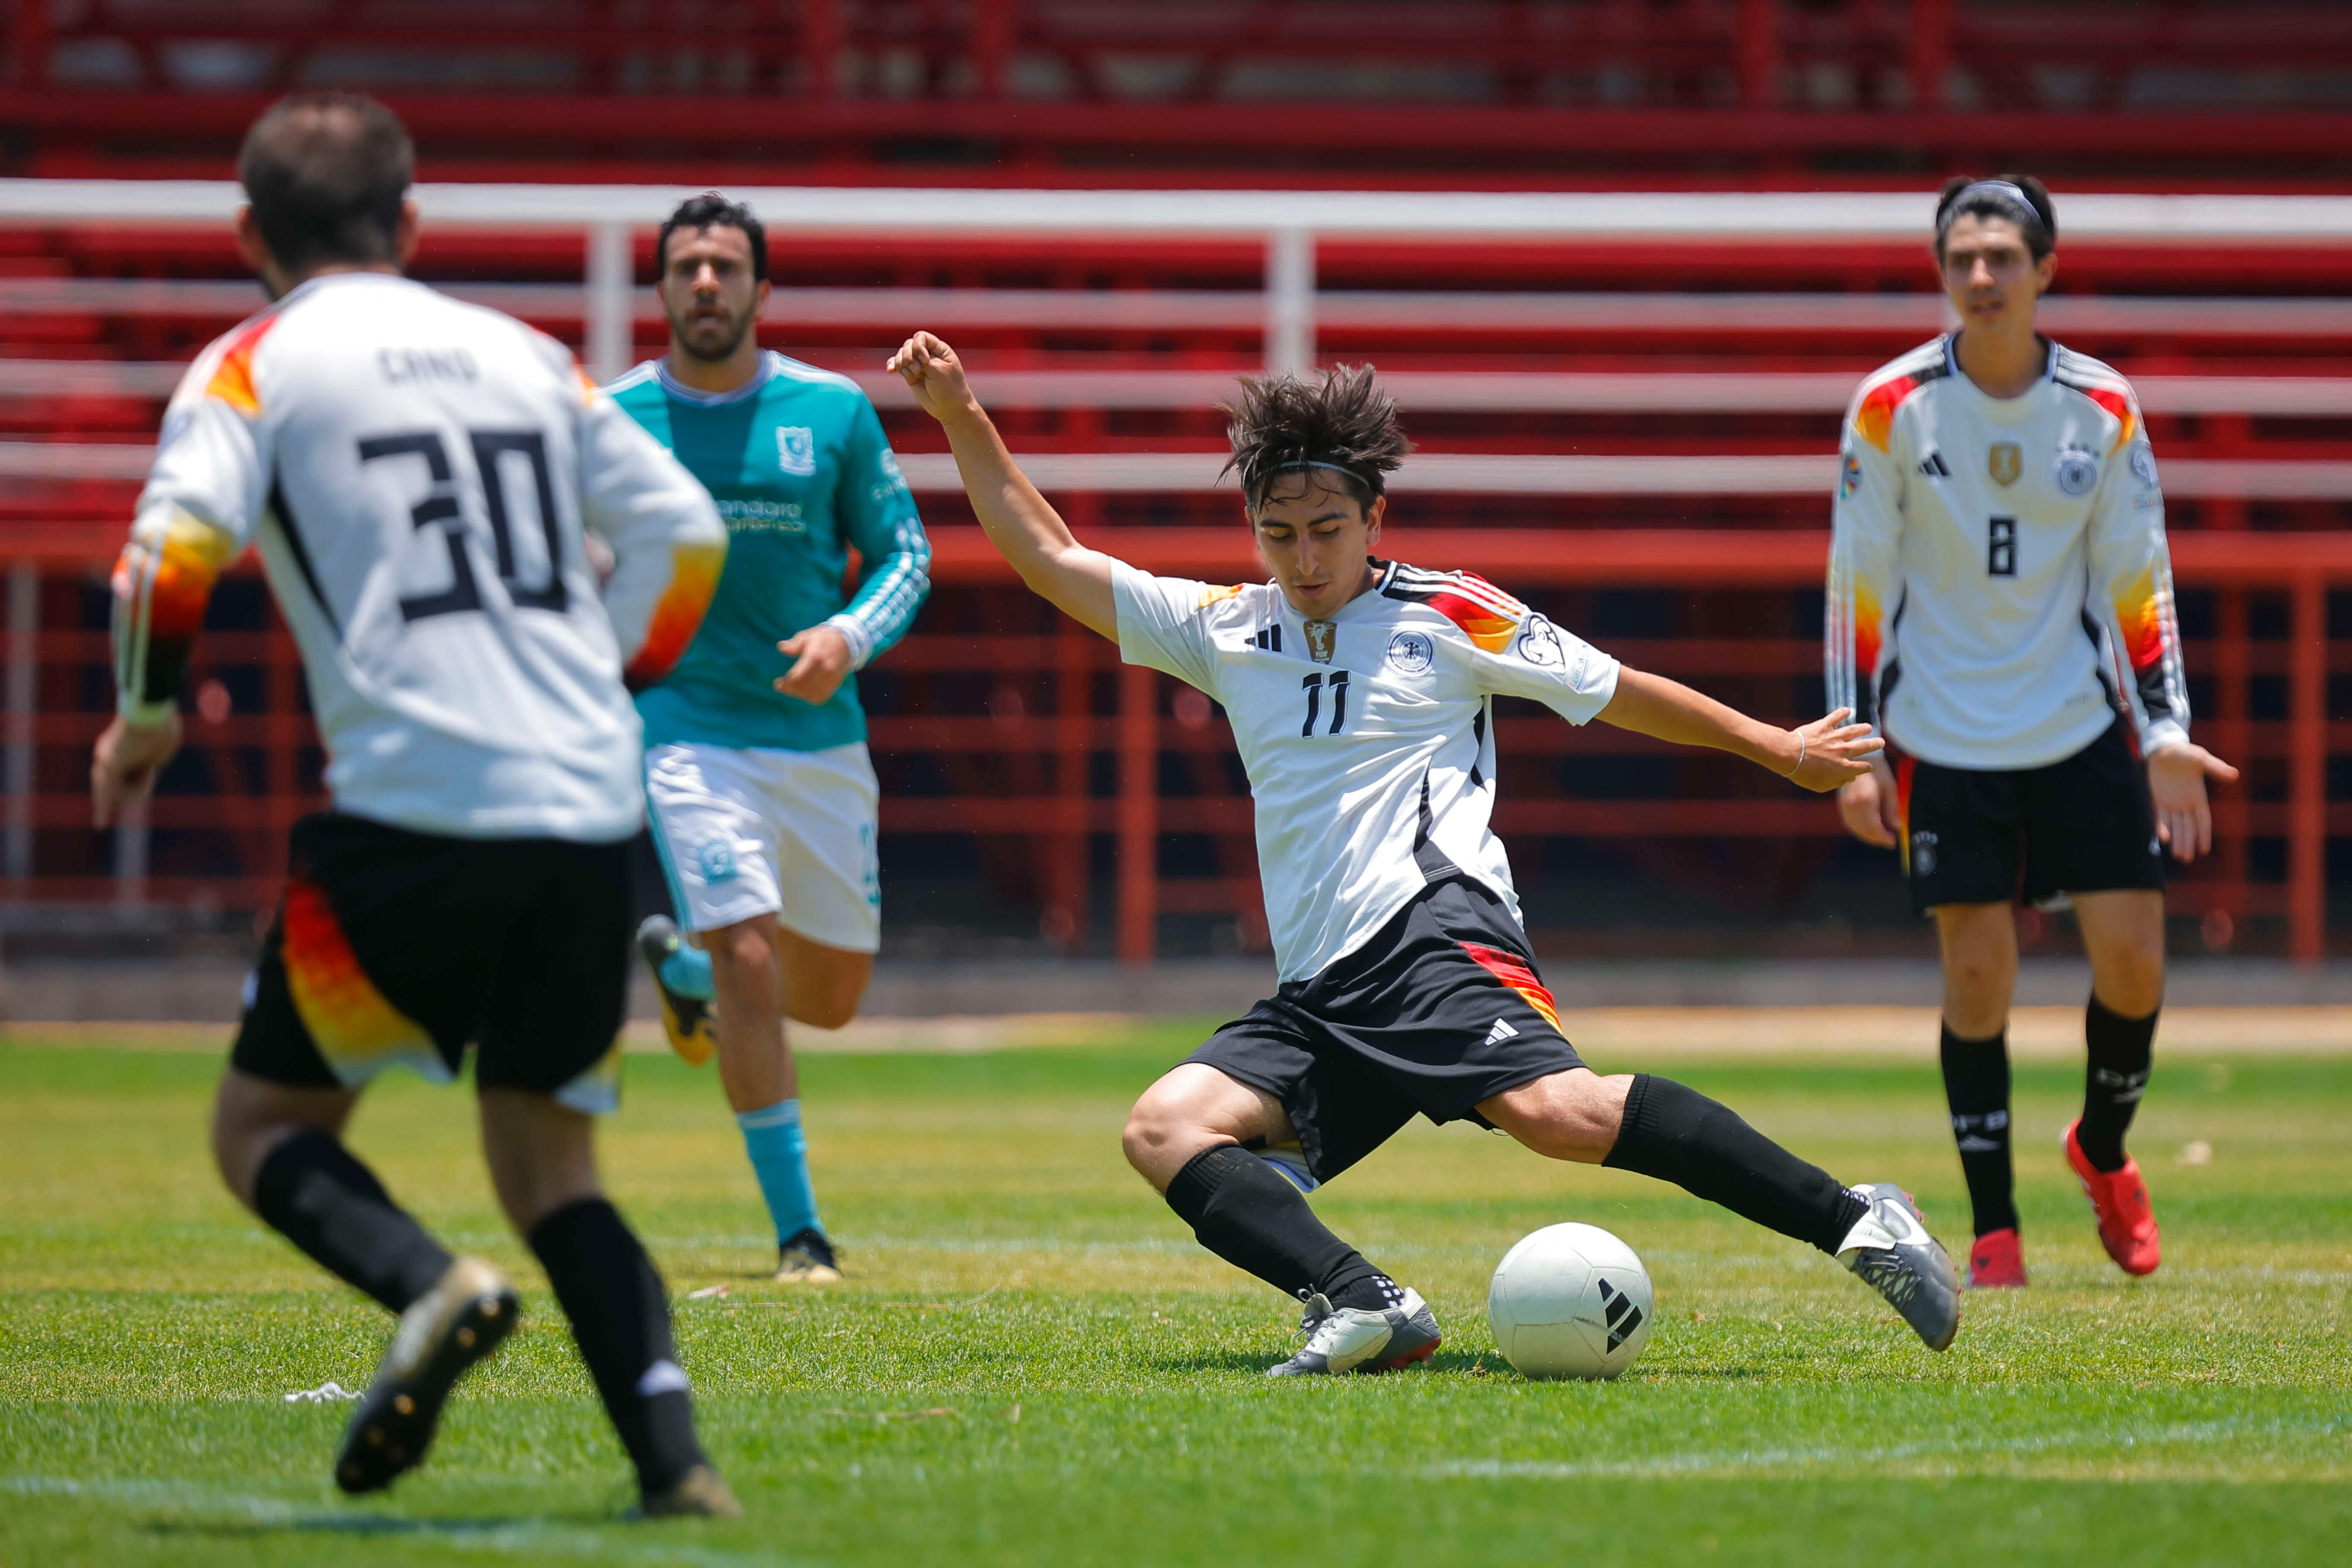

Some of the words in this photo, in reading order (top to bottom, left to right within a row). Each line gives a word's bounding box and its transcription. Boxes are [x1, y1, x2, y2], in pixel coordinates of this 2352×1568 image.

[358, 432, 567, 622] 30
[1989, 517, 2017, 576] 8
[1302, 671, 1351, 739] 11
[2096, 1068, 2150, 1089] DF
